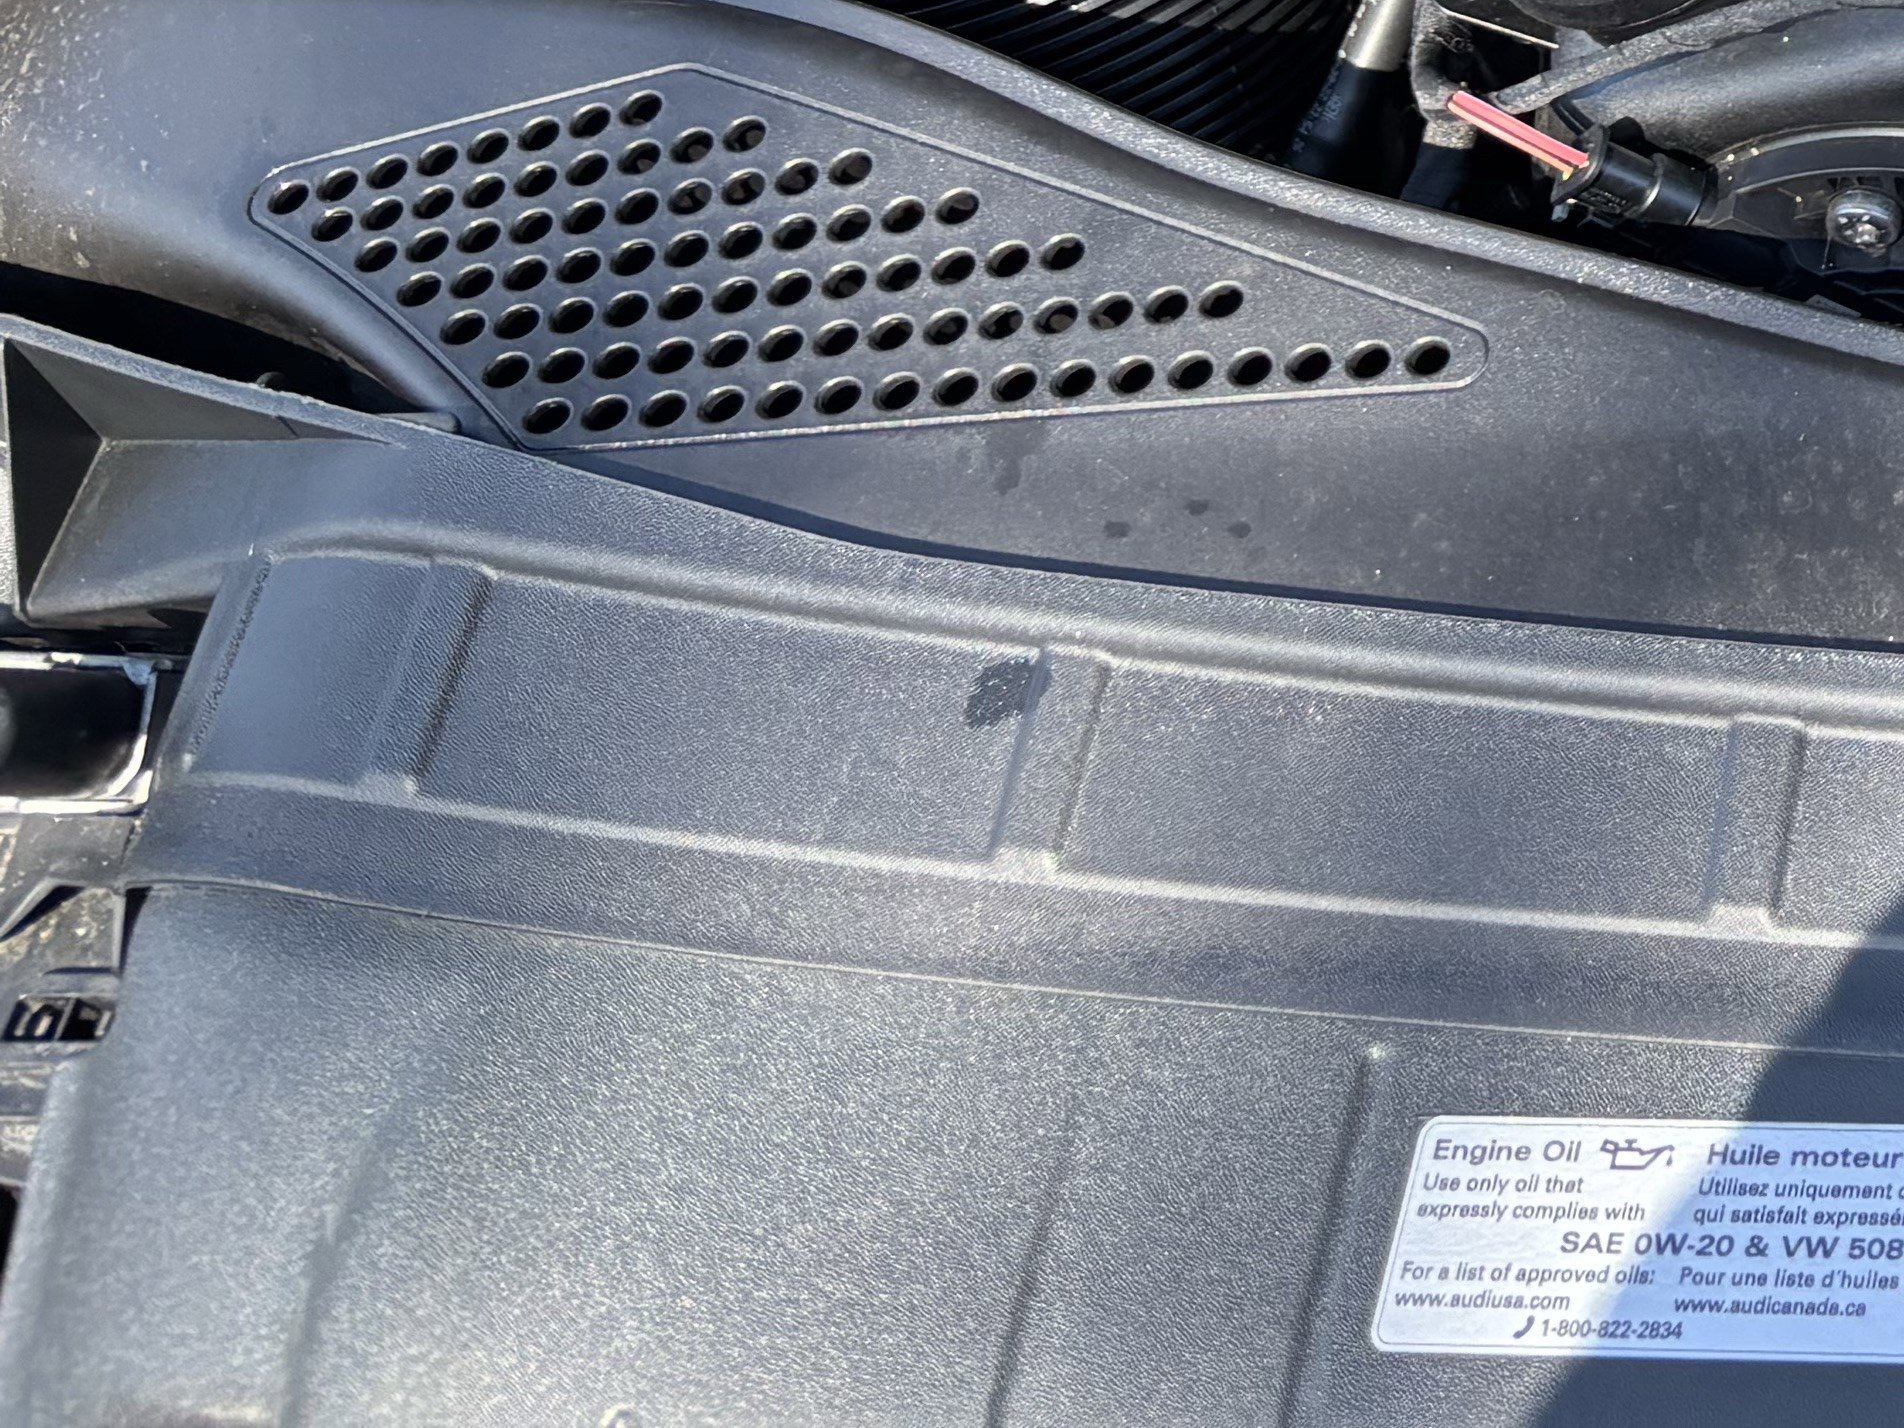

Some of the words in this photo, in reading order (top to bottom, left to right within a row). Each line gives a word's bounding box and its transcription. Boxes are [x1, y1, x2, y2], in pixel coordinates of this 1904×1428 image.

[1433, 1138, 1531, 1166] Engine
[1543, 1139, 1581, 1163] Oil
[1706, 1143, 1780, 1166] Huile
[1790, 1147, 1904, 1169] moteur
[1423, 1173, 1460, 1192] Use
[1467, 1175, 1510, 1196] only
[1515, 1175, 1539, 1193] oil
[1545, 1176, 1584, 1194] that
[1699, 1176, 1769, 1197] Utilisez
[1775, 1180, 1893, 1202] uniquement
[1417, 1201, 1509, 1222] expressly
[1512, 1204, 1599, 1223] complies
[1605, 1202, 1646, 1221] with
[1693, 1205, 1725, 1226] qui
[1731, 1205, 1807, 1226] satisfait
[1560, 1231, 1624, 1254] SAE
[1634, 1233, 1734, 1258] 0W-20
[1745, 1236, 1769, 1258] &
[1782, 1235, 1840, 1259] VW
[1849, 1237, 1904, 1261] 508
[1400, 1260, 1433, 1282] For
[1438, 1267, 1450, 1281] a
[1456, 1261, 1486, 1282] list
[1490, 1261, 1513, 1283] of
[1515, 1265, 1611, 1285] approved
[1615, 1265, 1656, 1285] oils:
[1679, 1266, 1726, 1286] Pour
[1731, 1272, 1768, 1287] une
[1774, 1268, 1816, 1288] liste
[1395, 1291, 1570, 1311] www.audiusa.com
[1674, 1297, 1866, 1317] www.audicanada.ca
[1541, 1319, 1684, 1339] 1-800-822-2834
